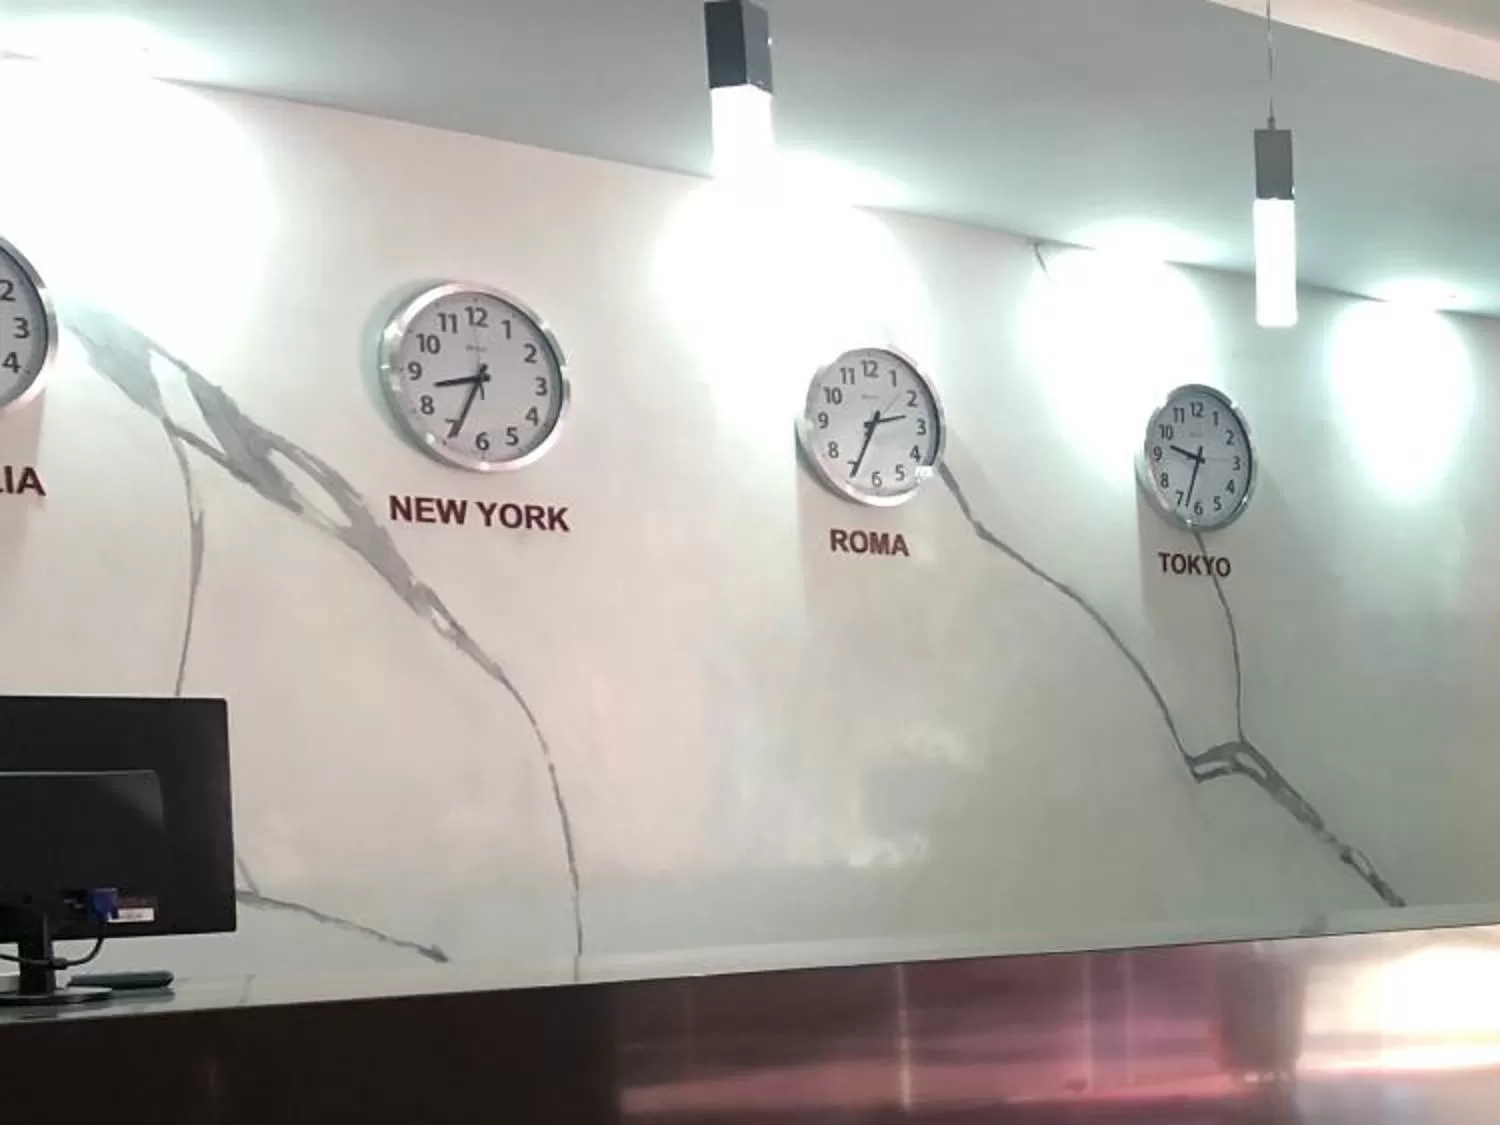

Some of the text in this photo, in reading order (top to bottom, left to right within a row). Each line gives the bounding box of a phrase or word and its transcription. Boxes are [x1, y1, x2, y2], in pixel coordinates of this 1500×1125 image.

[437, 312, 458, 334] 11
[464, 306, 489, 328] 12
[13, 317, 30, 339] 3
[501, 320, 512, 340] 1
[416, 333, 441, 354] 10
[1, 351, 21, 374] 4
[523, 344, 538, 364] 2
[407, 361, 422, 381] 9
[839, 367, 855, 385] 11
[860, 360, 879, 378] 12
[889, 369, 898, 387] 1
[534, 376, 548, 397] 3
[420, 395, 435, 415] 8
[823, 387, 842, 405] 10
[906, 390, 918, 408] 2
[525, 406, 539, 426] 4
[1172, 407, 1185, 424] 11
[1190, 402, 1204, 418] 12
[1212, 410, 1219, 427] 1
[817, 411, 829, 429] 9
[916, 418, 927, 436] 3
[505, 427, 519, 446] 5
[1158, 423, 1174, 440] 10
[1225, 429, 1235, 446] 2
[475, 432, 490, 451] 6
[828, 441, 839, 459] 8
[909, 444, 921, 463] 4
[1153, 446, 1162, 462] 9
[1232, 455, 1241, 471] 3
[0, 465, 46, 496] IA
[871, 471, 882, 488] 6
[895, 464, 905, 482] 5
[1160, 472, 1169, 489] 8
[1226, 480, 1235, 495] 4
[1176, 490, 1184, 506] 7
[1213, 495, 1222, 511] 5
[389, 495, 570, 533] NEW YORK
[1193, 501, 1204, 516] 6
[830, 529, 910, 557] ROMA
[1158, 551, 1231, 577] TOKYO
